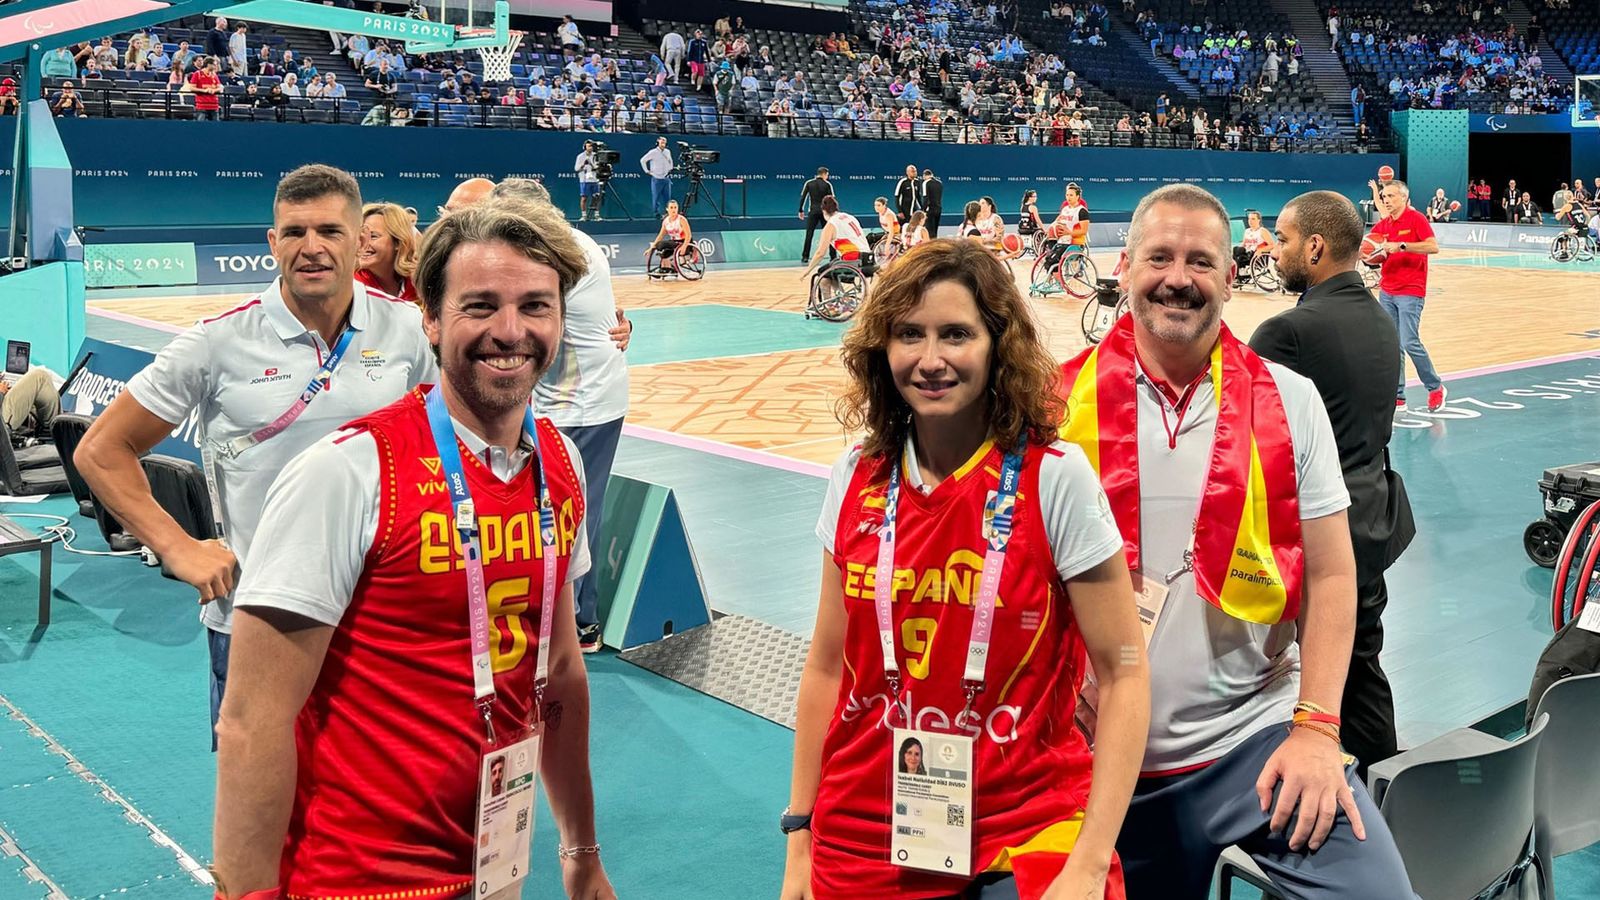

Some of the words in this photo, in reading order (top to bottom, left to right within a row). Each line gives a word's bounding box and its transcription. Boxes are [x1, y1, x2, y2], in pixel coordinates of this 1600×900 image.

[363, 17, 406, 32] PARIS
[411, 24, 449, 38] 2024
[600, 244, 620, 258] DF
[134, 258, 184, 272] 2024
[214, 256, 278, 272] TOYO
[417, 480, 449, 496] viv
[451, 472, 465, 496] Atos
[1004, 468, 1016, 492] Atos
[470, 566, 482, 604] 2024
[983, 558, 999, 599] PARIS
[474, 608, 486, 648] PARIS
[486, 576, 531, 674] 6
[976, 600, 990, 638] 2024
[902, 617, 938, 680] 9
[512, 864, 518, 877] 6
[945, 856, 953, 868] 6
